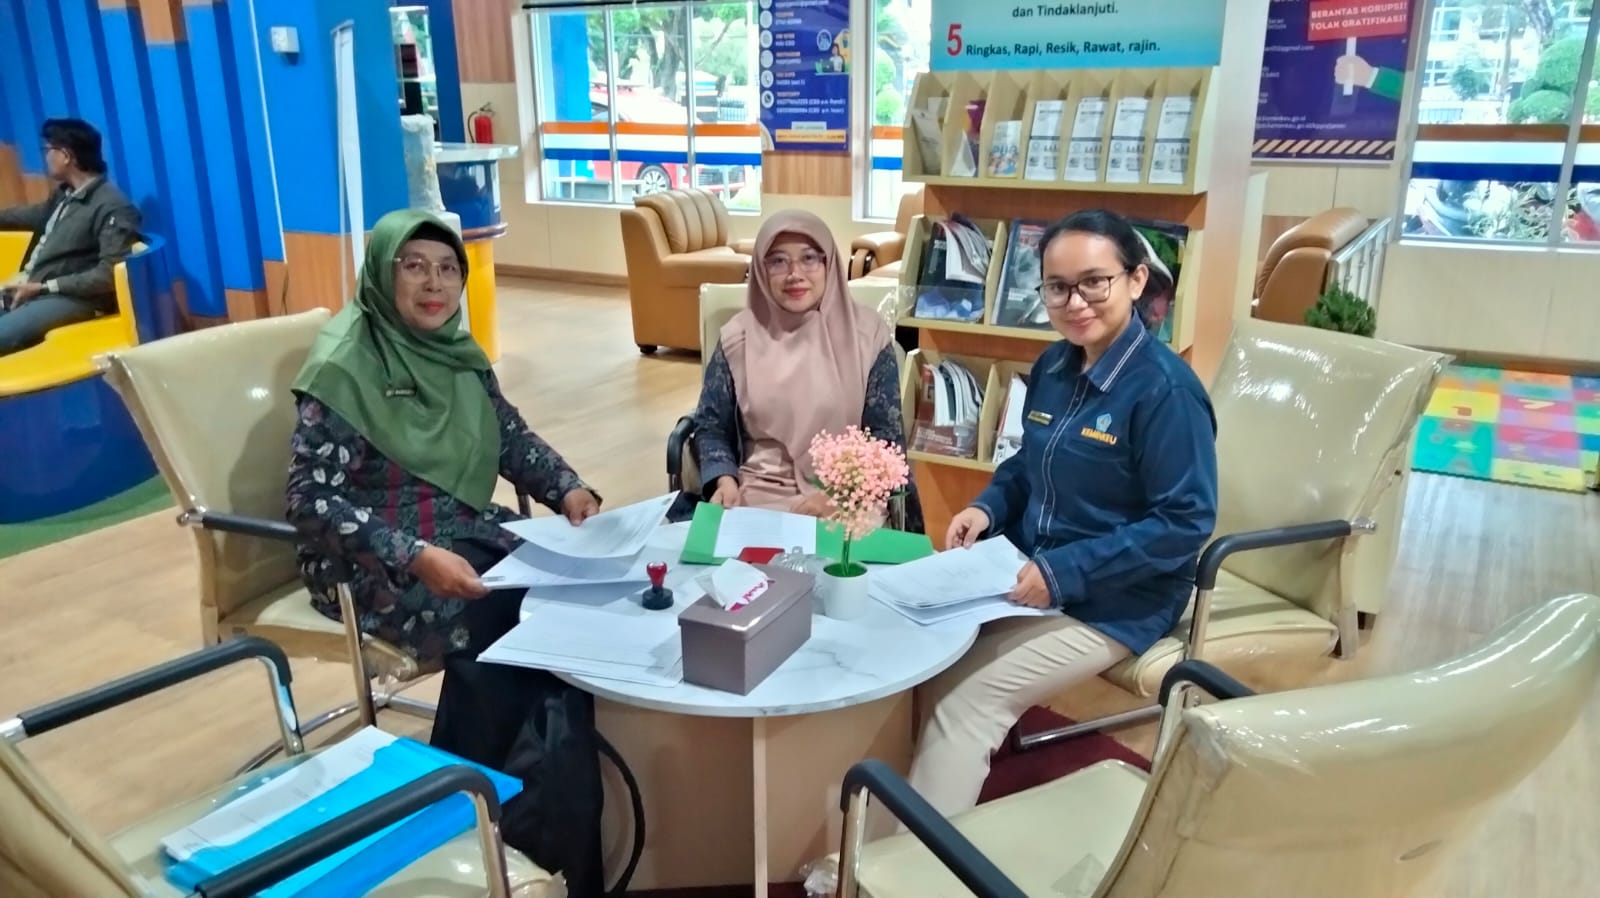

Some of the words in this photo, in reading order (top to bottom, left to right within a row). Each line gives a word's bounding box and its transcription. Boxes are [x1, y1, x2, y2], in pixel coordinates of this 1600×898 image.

[1012, 6, 1034, 18] dan
[1037, 2, 1118, 18] Tindaklanjuti.
[1311, 7, 1359, 19] BERANTAS
[1310, 20, 1340, 31] TOLAK
[947, 23, 962, 57] 5
[966, 42, 1011, 57] Ringkas,
[1014, 43, 1043, 56] Rapi,
[1046, 42, 1080, 55] Resik,
[1083, 40, 1125, 54] Rawat,
[1128, 39, 1161, 54] rajin.
